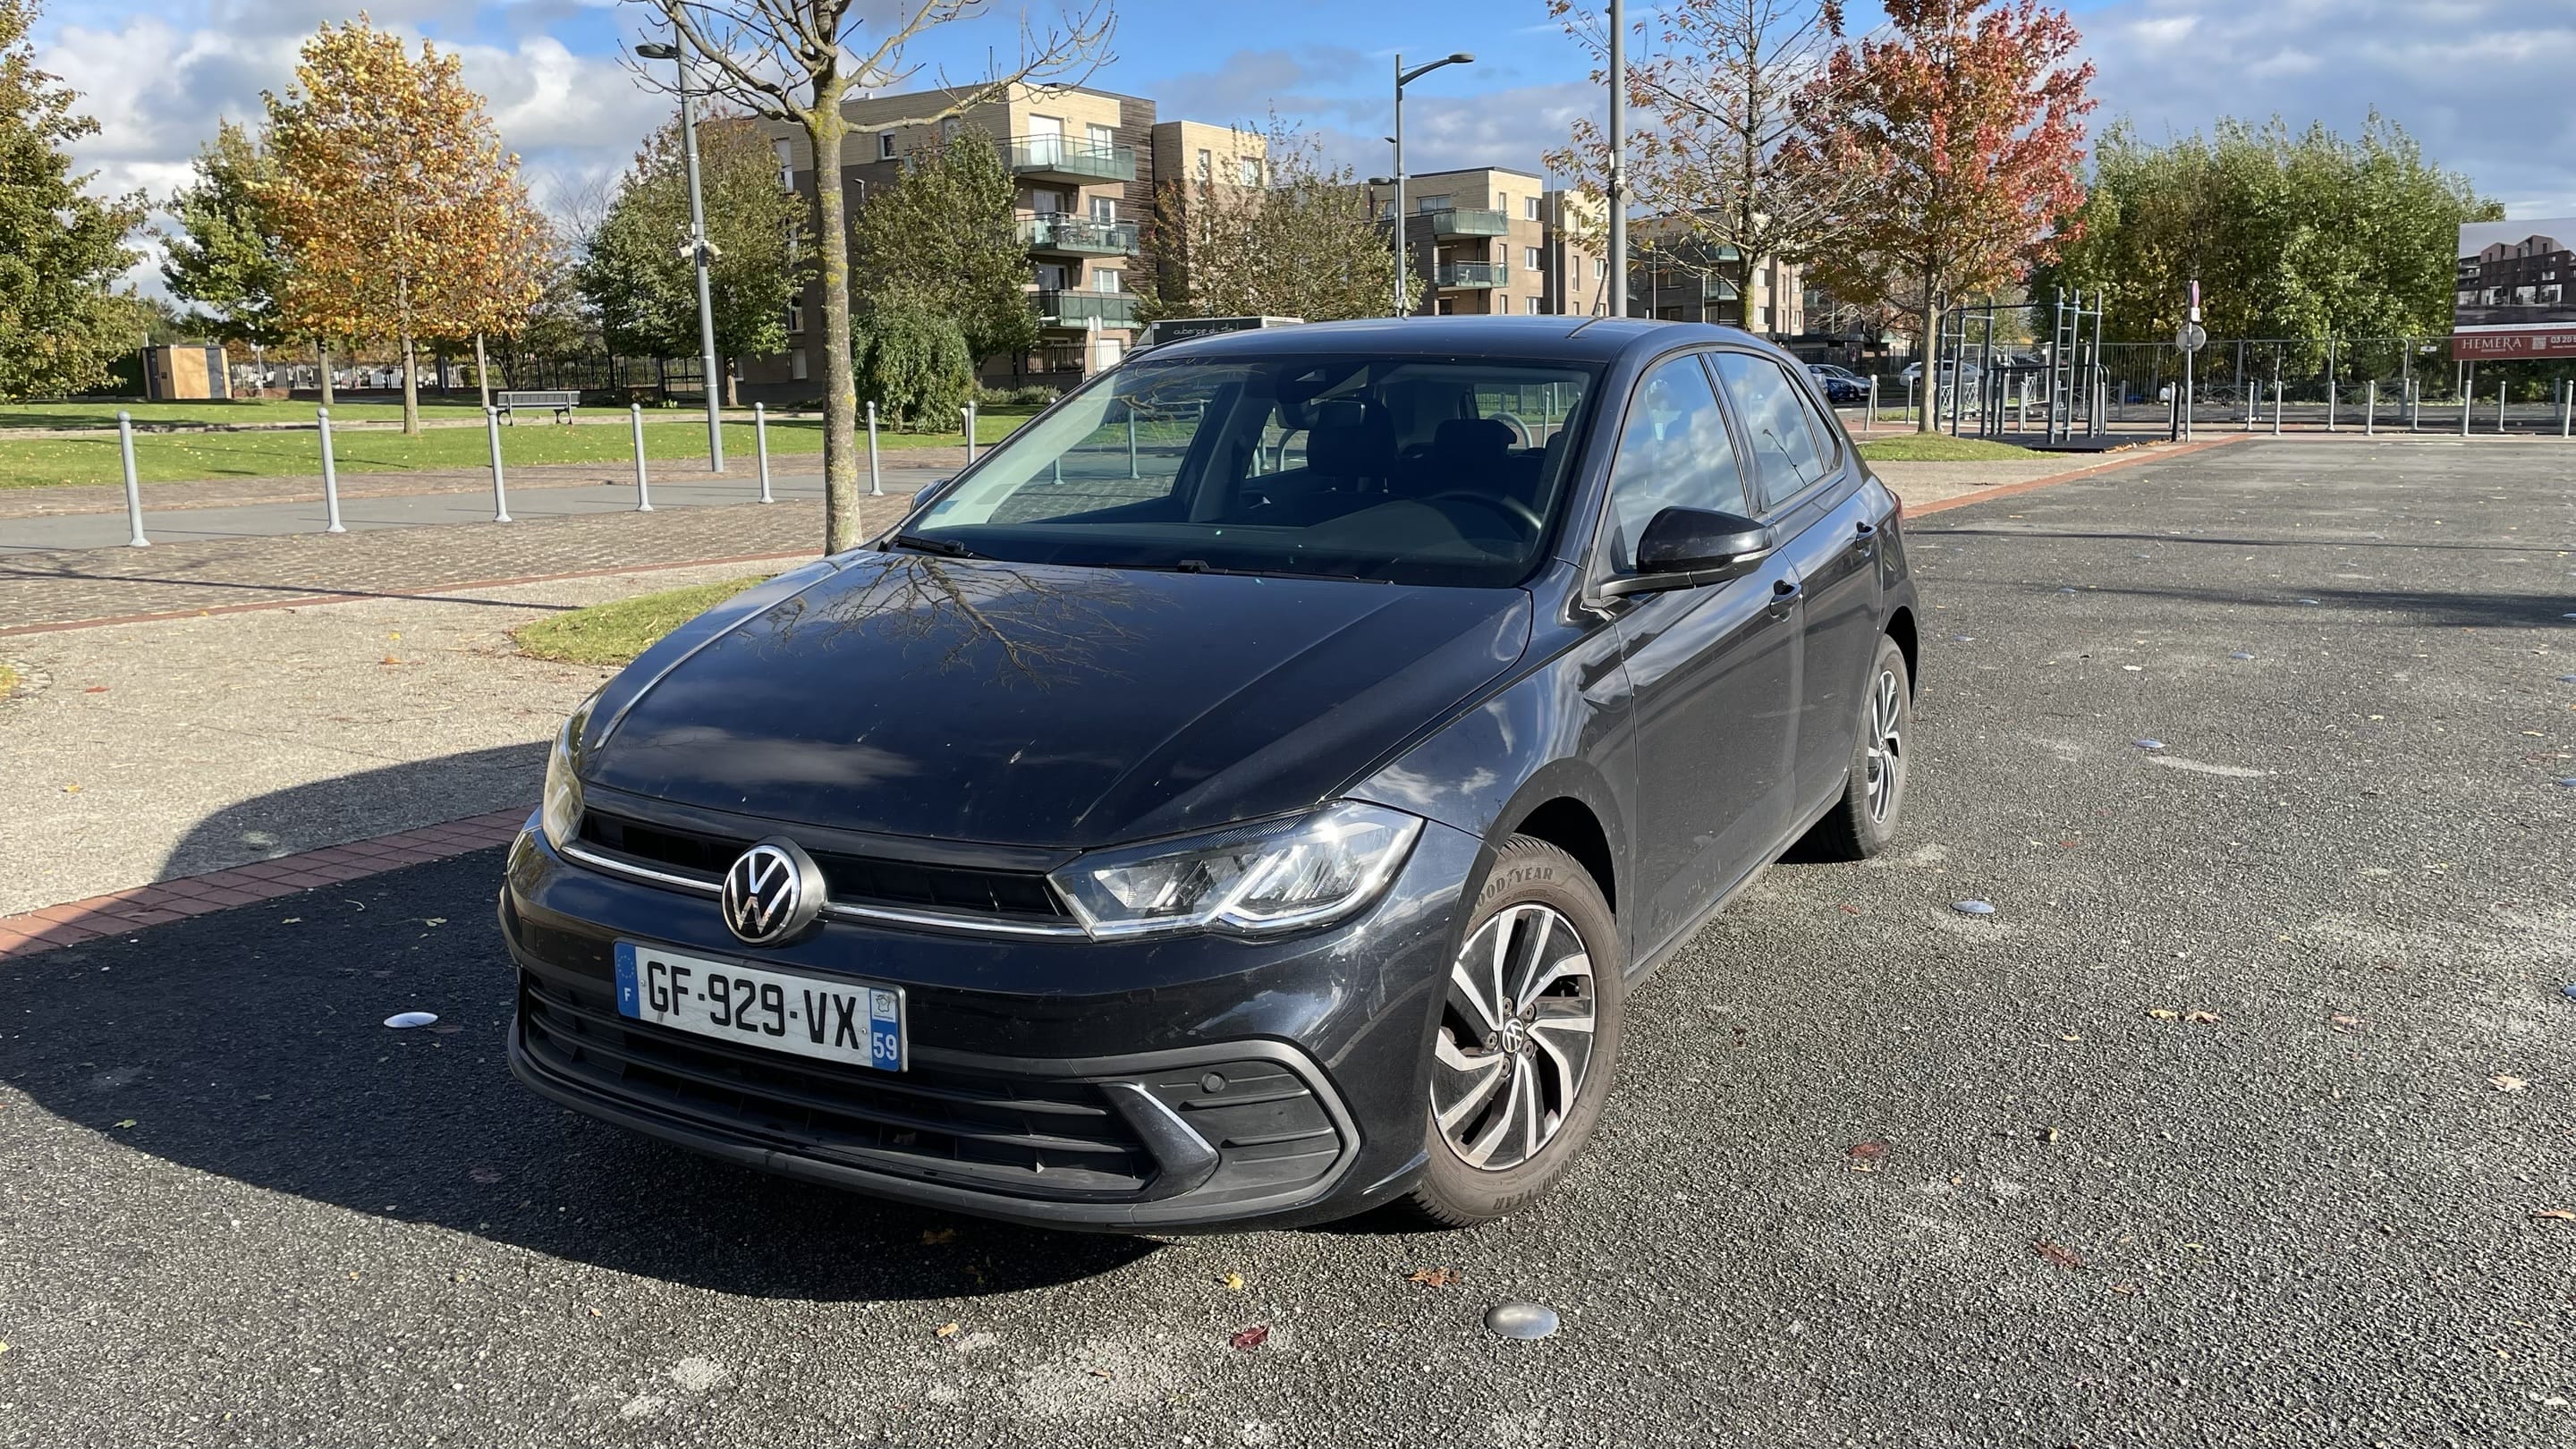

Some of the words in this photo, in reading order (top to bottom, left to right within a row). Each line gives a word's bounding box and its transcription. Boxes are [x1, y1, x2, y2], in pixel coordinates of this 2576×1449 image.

[2461, 337, 2522, 352] HEMERA
[1476, 866, 1554, 907] OODYEAR
[623, 987, 631, 1003] F
[646, 960, 860, 1050] GF-929-VX
[872, 1031, 898, 1062] 59
